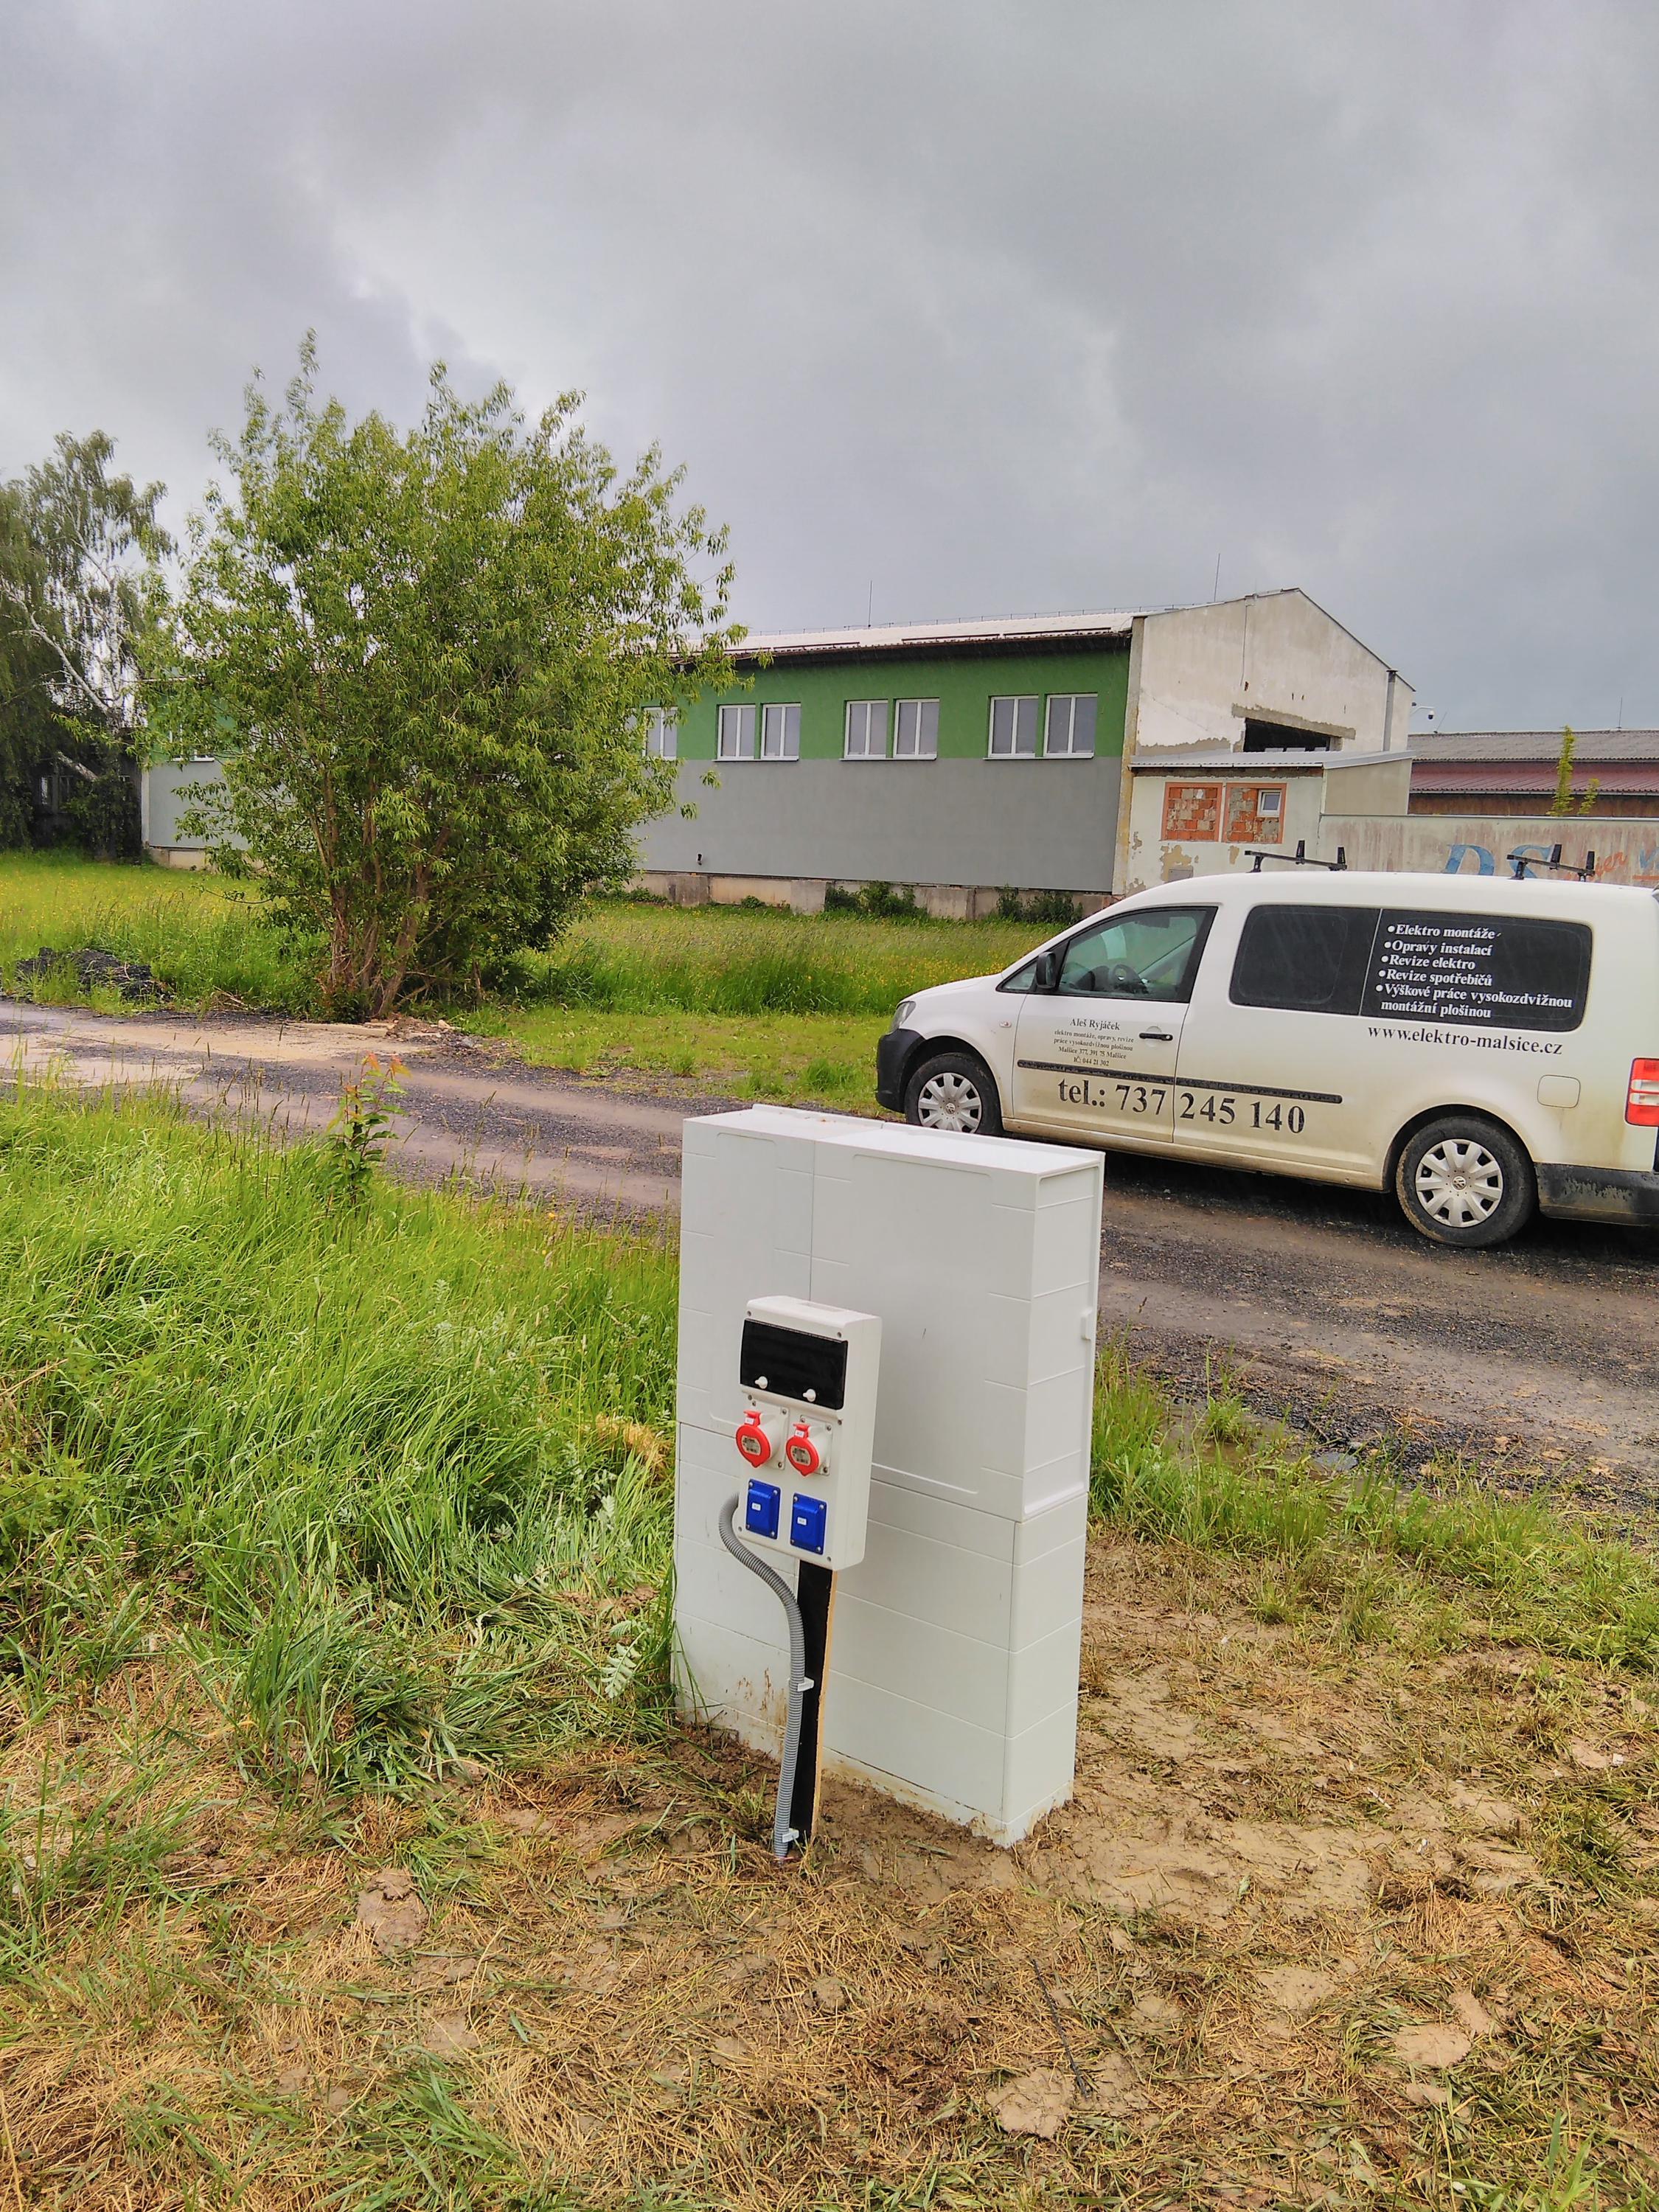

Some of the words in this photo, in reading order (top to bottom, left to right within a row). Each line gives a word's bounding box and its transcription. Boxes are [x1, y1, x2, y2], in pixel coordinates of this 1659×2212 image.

[1395, 924, 1440, 937] Elektro
[1443, 925, 1495, 939] montáže
[1391, 939, 1438, 954] Opravy
[1440, 942, 1493, 956] instalací
[1388, 954, 1430, 967] Revize
[1432, 957, 1475, 970] elektro
[1385, 968, 1427, 982] Revize
[1429, 971, 1492, 987] spotřebičů
[1385, 983, 1430, 998] Výškové
[1433, 987, 1467, 1002] práce
[1470, 992, 1573, 1008] vysokozdvižnou
[1380, 1000, 1437, 1015] montážní
[1439, 1003, 1492, 1018] plošinou
[1070, 1018, 1087, 1027] Aleš
[1088, 1019, 1120, 1031] Ryjáček
[1368, 1026, 1563, 1056] www.elektro-malsice.cz
[1057, 1079, 1106, 1108] tel.:
[1115, 1084, 1166, 1116] 737
[1180, 1092, 1237, 1124] 245
[1250, 1101, 1305, 1134] 140
